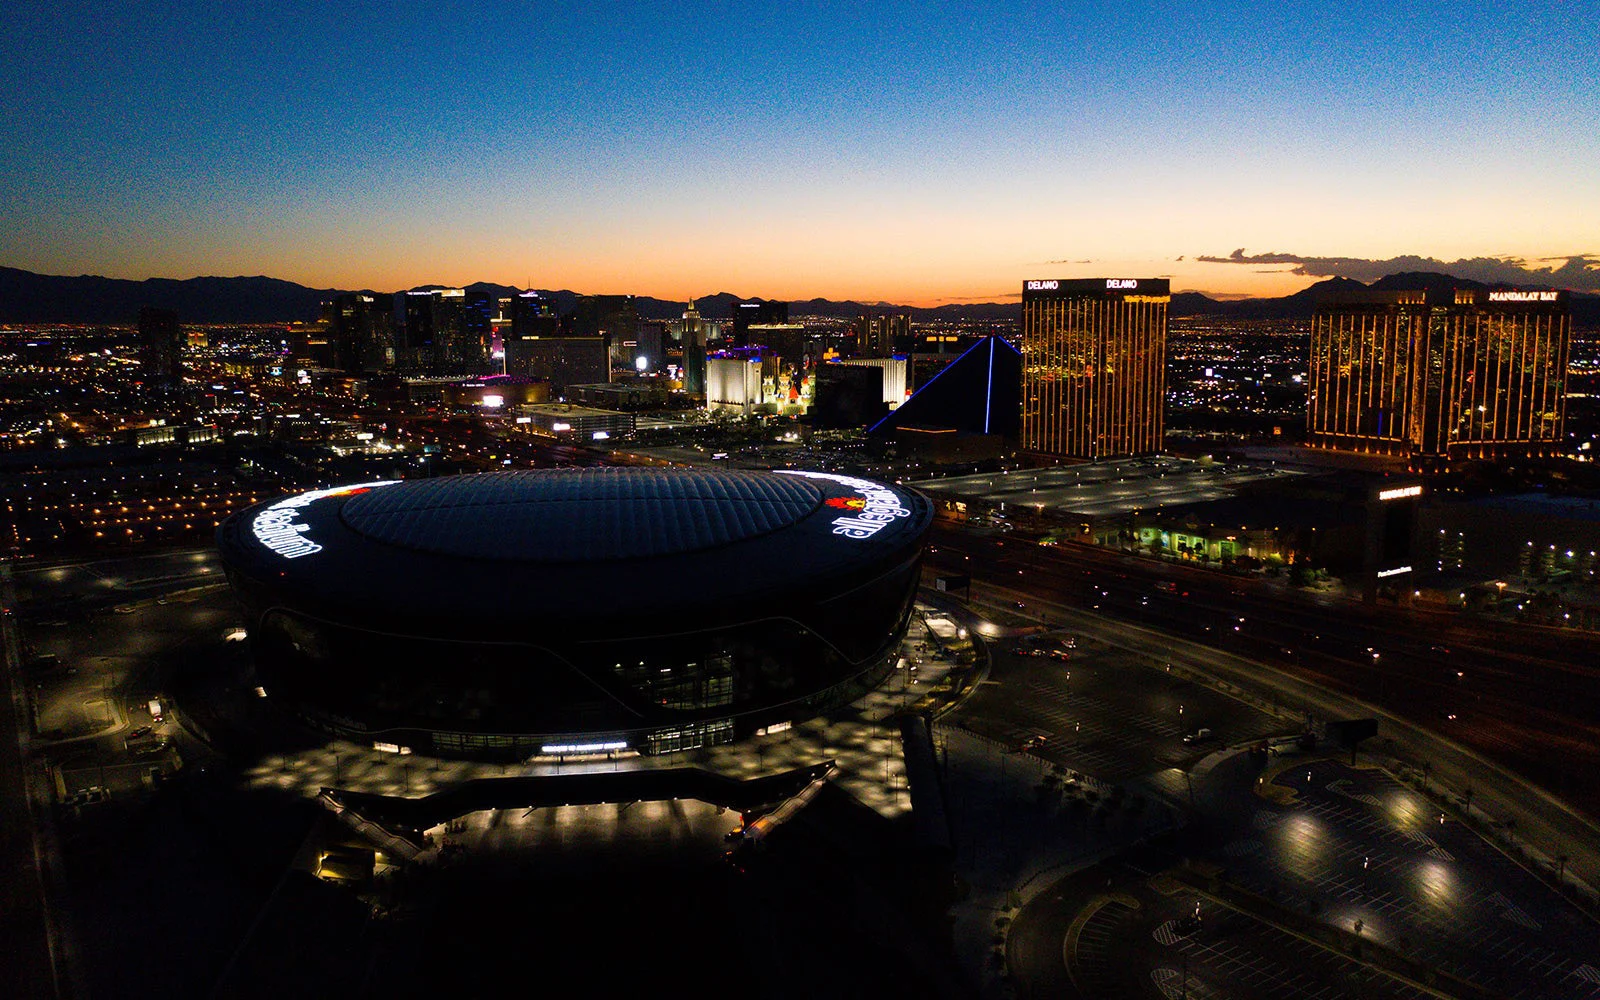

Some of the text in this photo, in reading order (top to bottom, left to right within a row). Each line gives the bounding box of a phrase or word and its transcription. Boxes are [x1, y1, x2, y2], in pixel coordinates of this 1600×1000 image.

[1027, 280, 1059, 290] DELANO
[1106, 279, 1138, 289] DELANO
[1488, 291, 1558, 301] MANDALAY BAY
